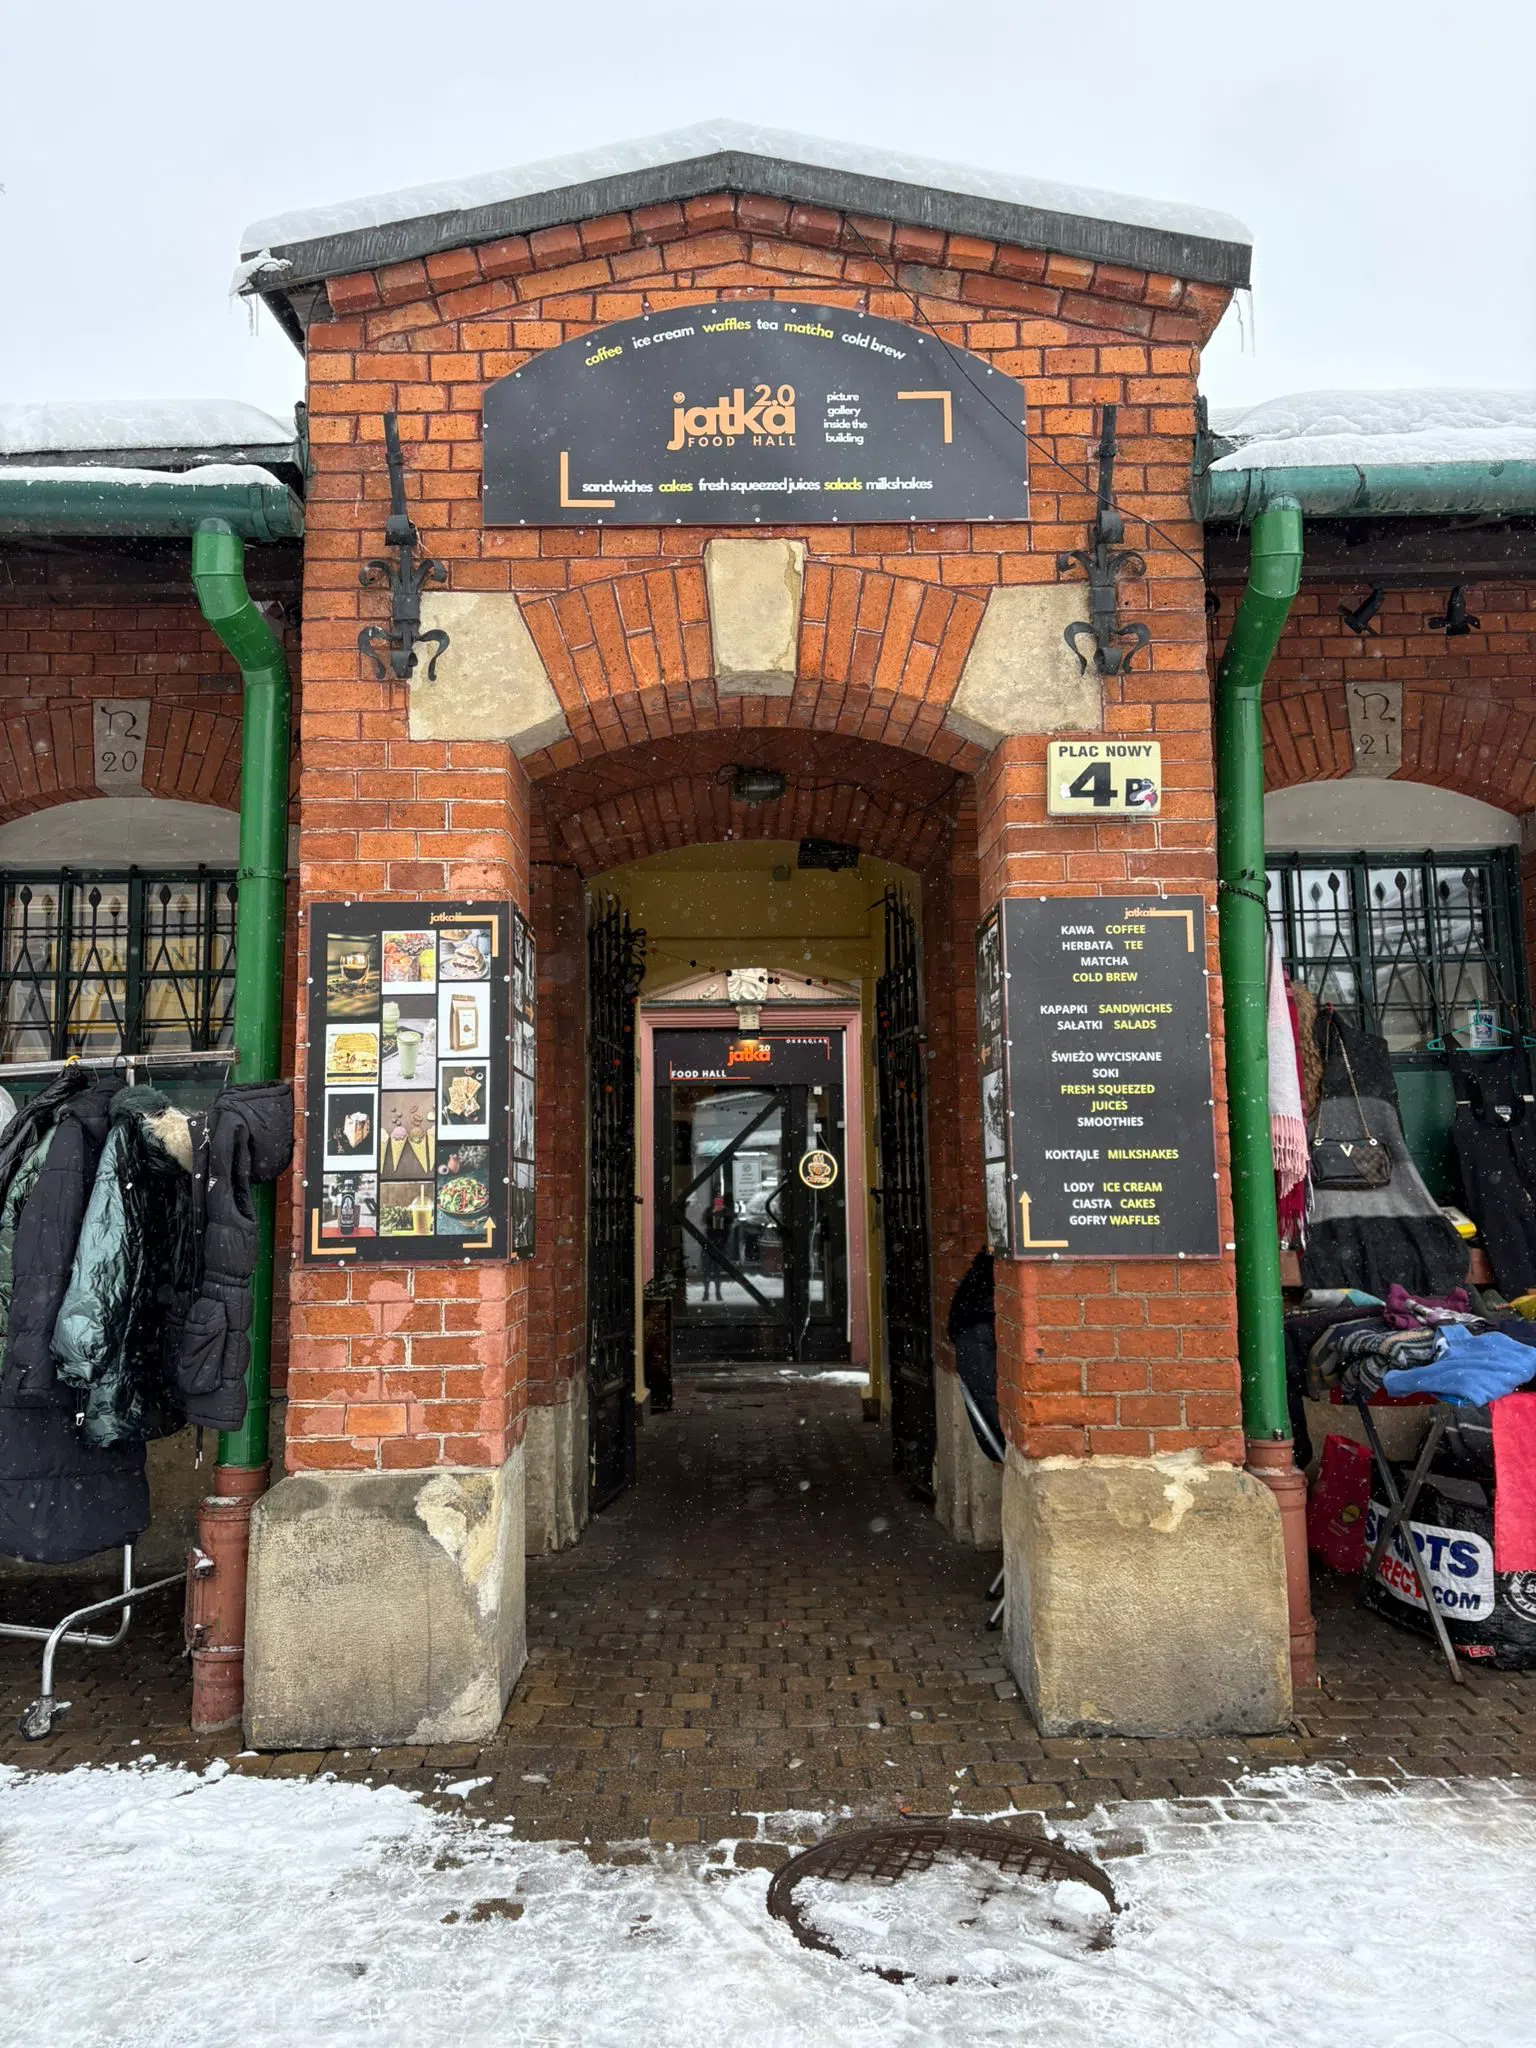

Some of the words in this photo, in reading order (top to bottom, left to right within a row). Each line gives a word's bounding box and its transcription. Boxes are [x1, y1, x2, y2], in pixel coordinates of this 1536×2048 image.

[585, 344, 623, 366] coffee
[632, 336, 652, 350] ice
[652, 326, 695, 344] cream
[702, 317, 752, 333] waffles
[756, 318, 779, 331] tea
[784, 322, 834, 339] matcha
[842, 332, 870, 348] cold
[870, 337, 906, 360] brew
[826, 392, 859, 404] picture
[667, 388, 795, 450] jatka
[754, 383, 795, 408] 2.0
[827, 405, 861, 418] gallery
[824, 419, 850, 430] inside
[852, 419, 867, 430] the
[687, 437, 736, 447] FOOD
[753, 436, 796, 447] HALL
[826, 432, 864, 445] building
[582, 480, 653, 493] sandwiches
[659, 480, 693, 493] cakes
[699, 479, 729, 492] fresh
[731, 479, 787, 493] squeezed
[788, 479, 820, 493] juices
[824, 479, 863, 491] salads
[866, 478, 933, 490] milkshakes
[1359, 733, 1390, 755] 21
[1058, 745, 1098, 757] PLAC
[1106, 745, 1152, 757] NOWY
[101, 750, 138, 773] 20
[430, 912, 454, 924] jatka
[1125, 907, 1151, 919] jatka
[1061, 925, 1094, 935] KAWA
[1105, 925, 1146, 934] COFFEE
[1062, 941, 1113, 950] HERBATA
[1124, 941, 1143, 950] TEE
[1081, 957, 1128, 966] MATCHA
[1073, 973, 1103, 982] COLD
[1106, 972, 1137, 981] BREW
[1040, 1005, 1087, 1014] KAPAPKI
[1099, 1003, 1172, 1013] SANDWICHES
[1057, 1020, 1102, 1030] SAŁATKI
[1114, 1020, 1156, 1029] SALADS
[728, 1045, 770, 1066] jatka
[1052, 1051, 1093, 1062] ŚWIEŻO
[1096, 1052, 1162, 1061] WYCISKANE
[672, 1070, 699, 1078] FOOD
[702, 1070, 727, 1078] HALL
[1092, 1068, 1118, 1078] SOKI
[1061, 1085, 1094, 1094] FRESH
[1098, 1085, 1155, 1095] SQUEEZED
[1091, 1101, 1128, 1111] JUICES
[1078, 1117, 1143, 1126] SMOOTHIES
[1045, 1150, 1099, 1160] KOKTAJLE
[1108, 1150, 1178, 1159] MILKSHAKES
[1064, 1183, 1094, 1192] LODY
[1103, 1183, 1120, 1191] ICE
[1123, 1182, 1162, 1191] CREAM
[1073, 1199, 1111, 1208] CIASTA
[1120, 1198, 1155, 1208] CAKES
[1070, 1215, 1106, 1225] GOFRY
[1110, 1215, 1160, 1225] WAFFLES
